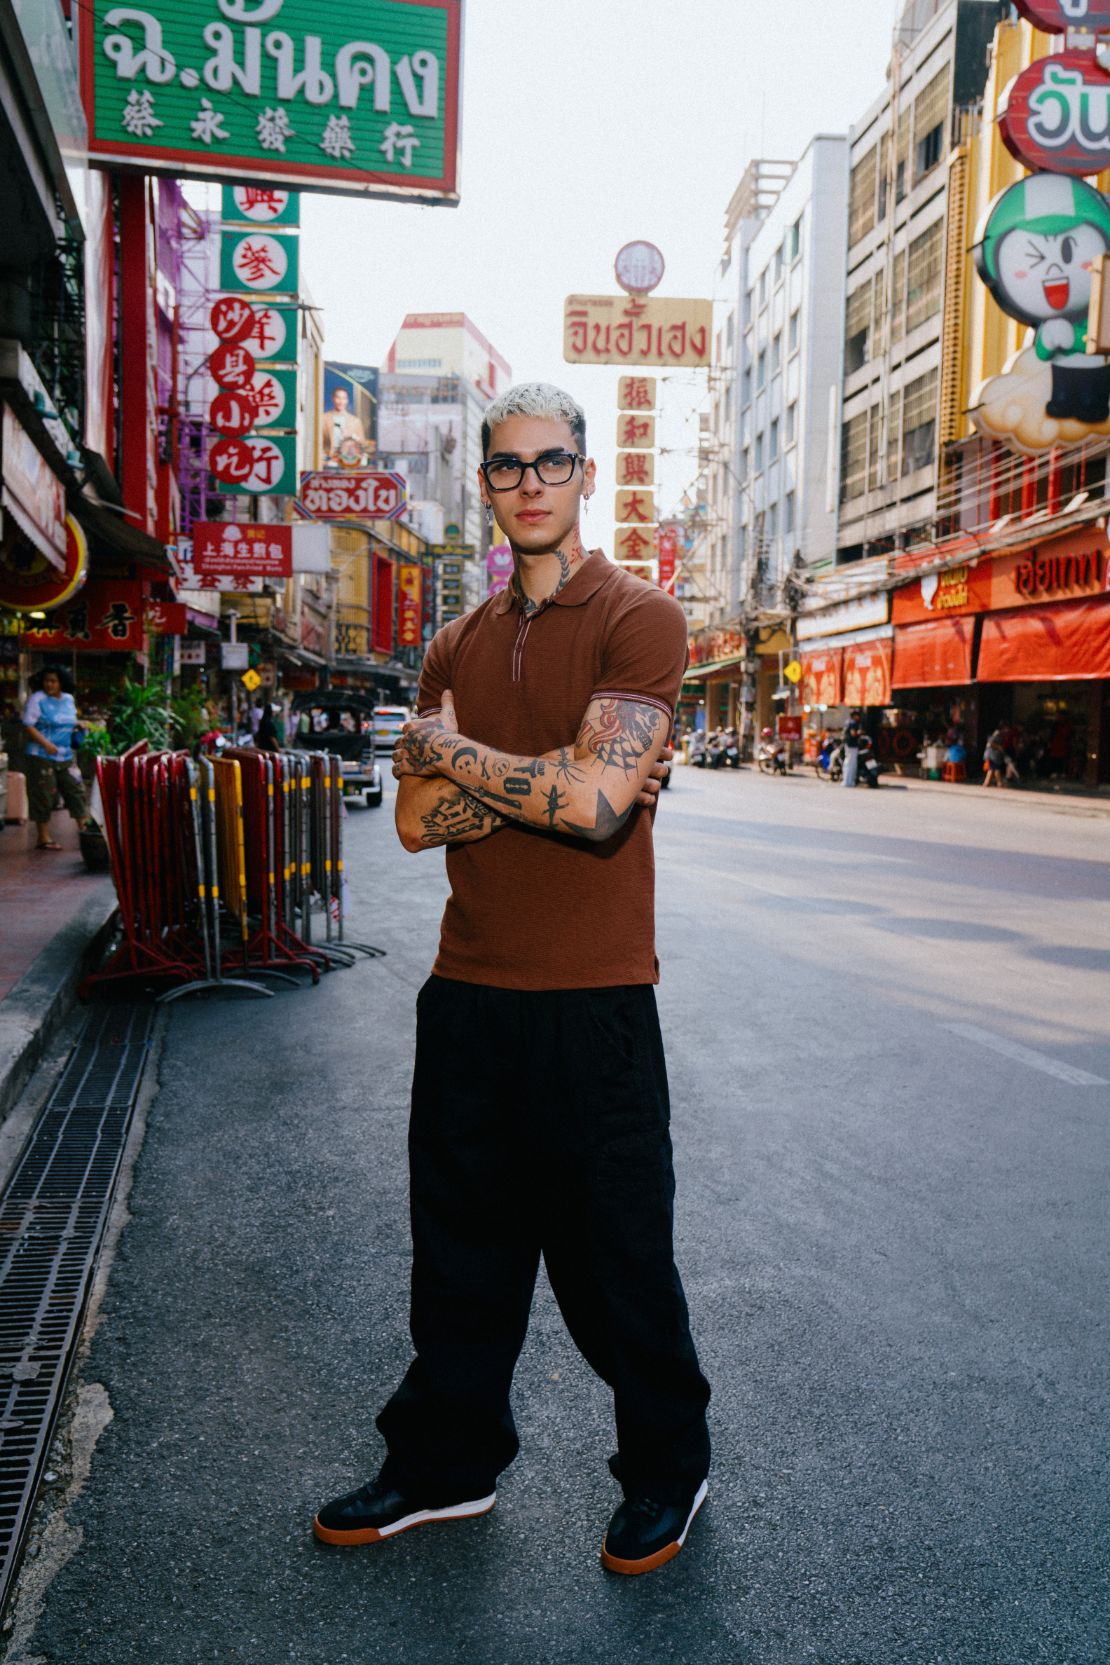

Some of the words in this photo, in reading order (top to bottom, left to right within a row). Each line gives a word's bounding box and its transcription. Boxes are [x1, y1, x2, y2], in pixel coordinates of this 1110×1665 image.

[121, 88, 421, 168] 蔡永發藥行
[215, 302, 250, 476] 沙县小吃
[203, 541, 283, 559] 上海生煎包
